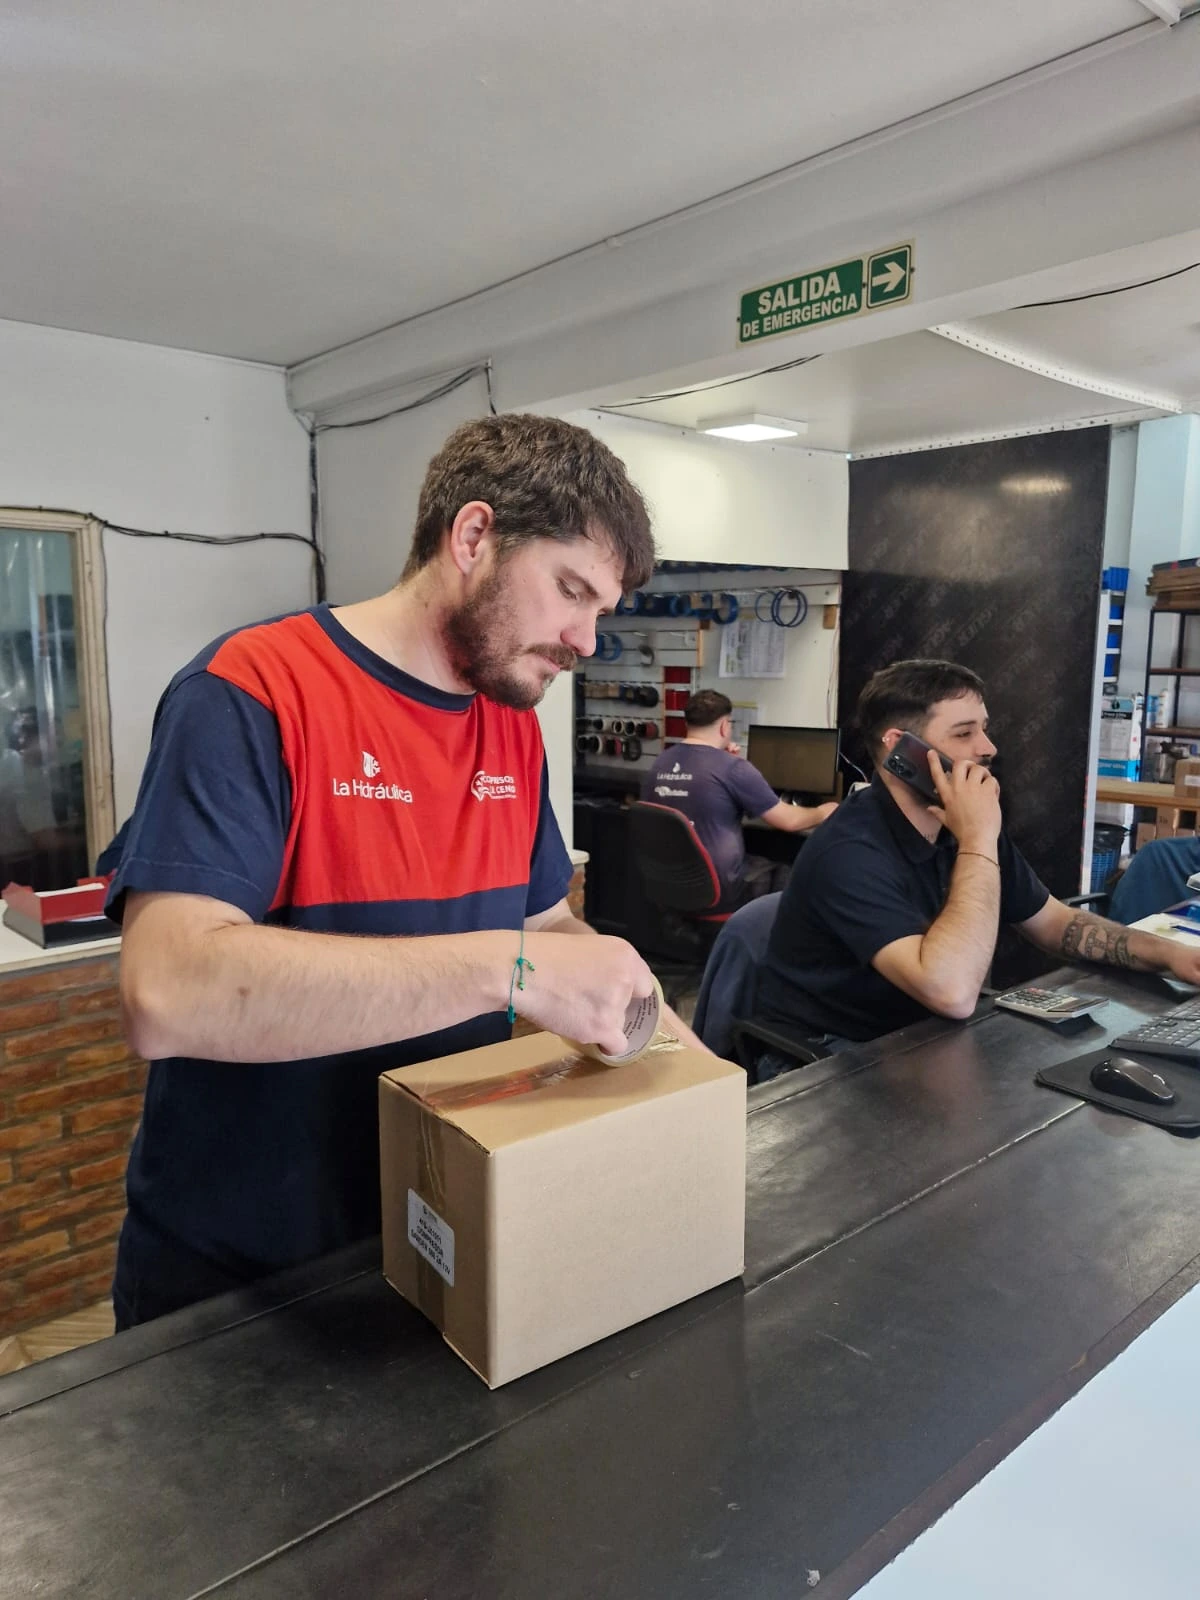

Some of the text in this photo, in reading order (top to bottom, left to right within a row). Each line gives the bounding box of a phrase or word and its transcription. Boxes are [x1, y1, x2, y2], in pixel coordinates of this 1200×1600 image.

[758, 271, 842, 315] SALIDA
[742, 293, 858, 339] DE EMERGENCIA
[332, 778, 351, 796] La
